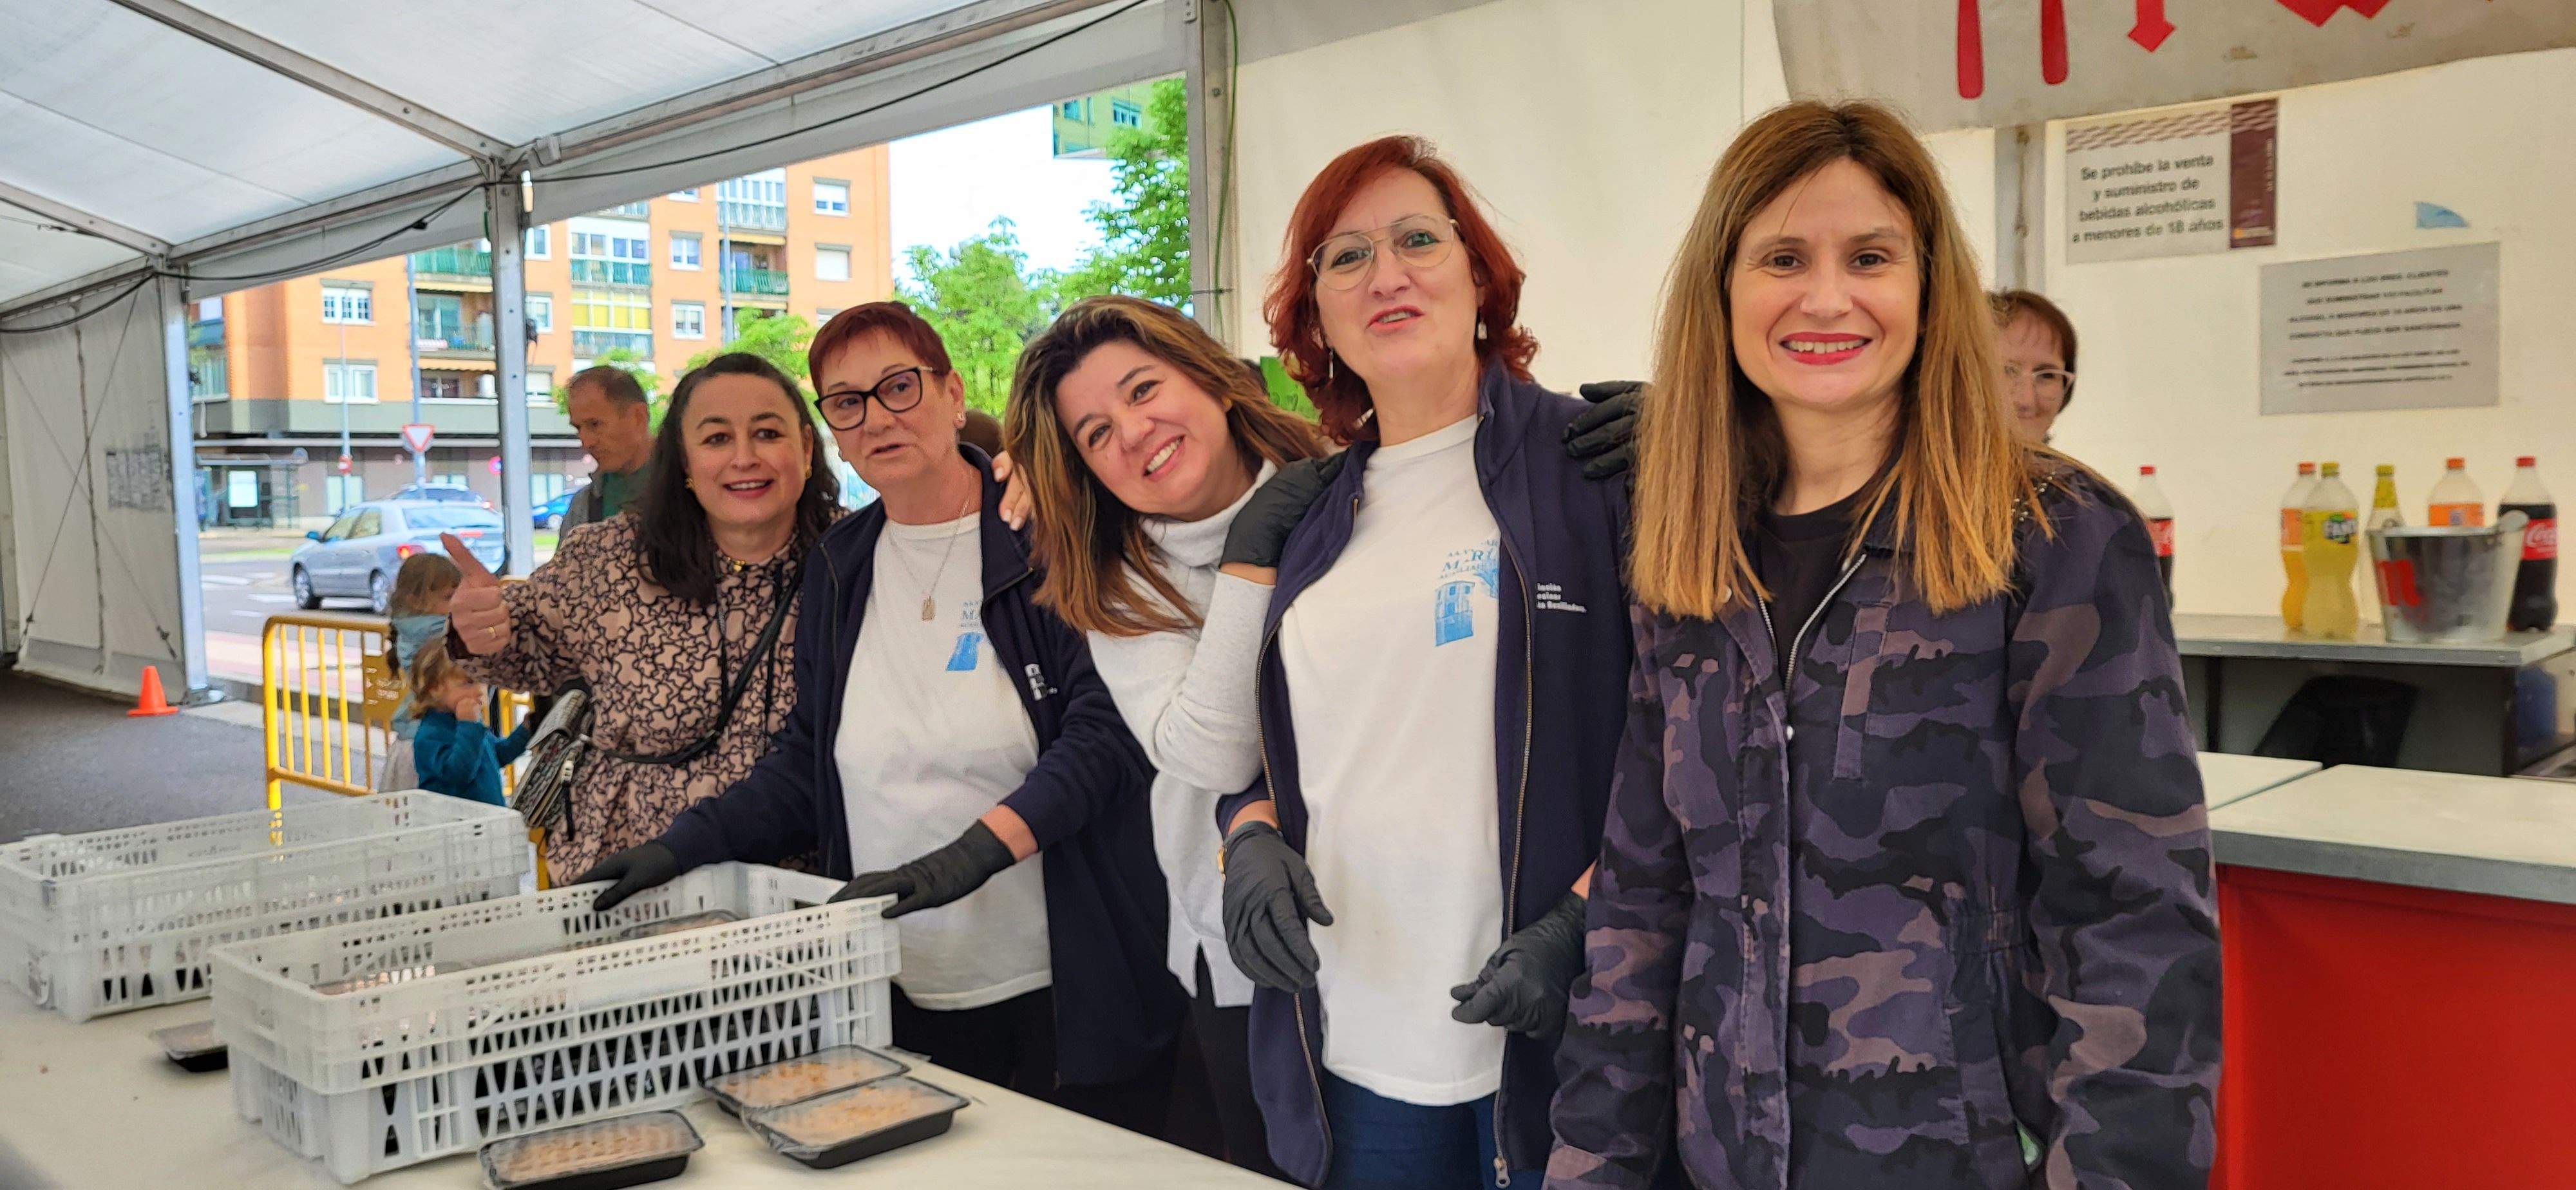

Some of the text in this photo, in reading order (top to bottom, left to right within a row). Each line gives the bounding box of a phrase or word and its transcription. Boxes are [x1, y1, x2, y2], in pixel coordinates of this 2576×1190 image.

[2081, 167, 2098, 181] Se
[2158, 160, 2170, 171] la
[2175, 155, 2214, 169] venta
[2104, 180, 2177, 198] suministro
[2181, 176, 2200, 190] de
[2079, 198, 2216, 222] bebidas alcohólicas
[2072, 219, 2224, 243] a menores de 18 años
